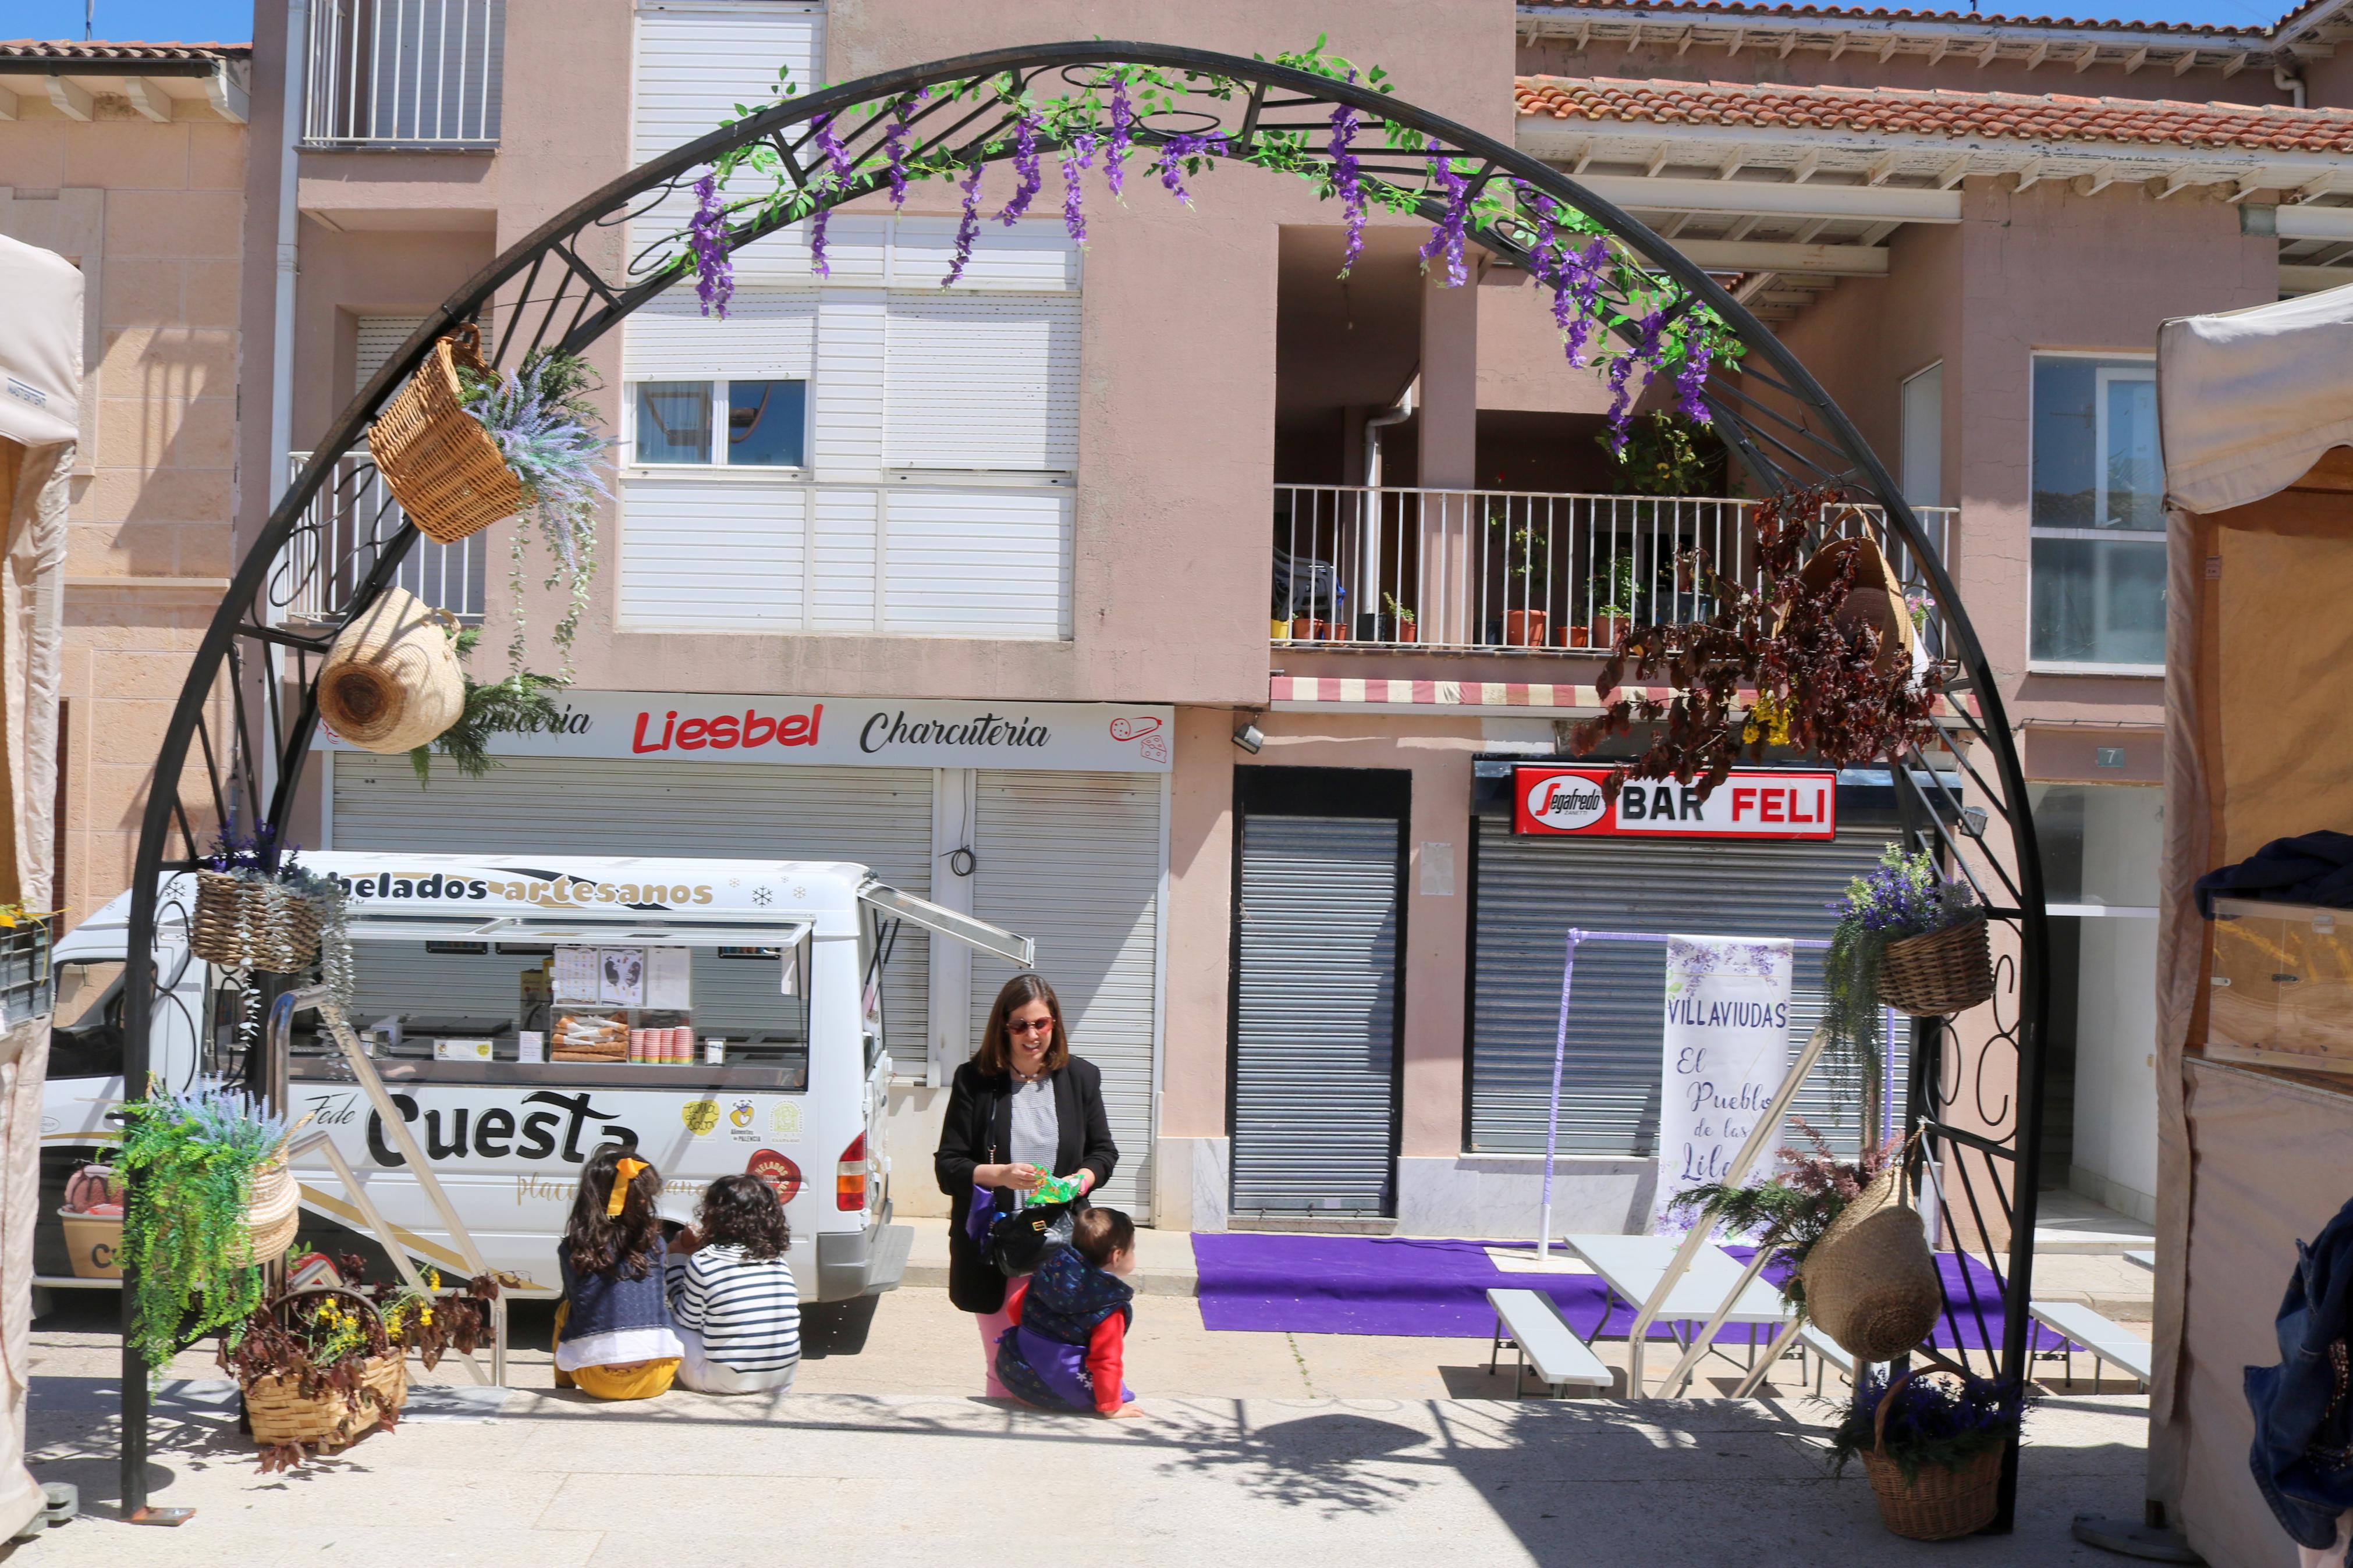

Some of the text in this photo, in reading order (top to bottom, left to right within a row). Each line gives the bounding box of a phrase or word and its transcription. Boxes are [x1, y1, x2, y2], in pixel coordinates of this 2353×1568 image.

[633, 703, 824, 753] Liesbel
[2107, 749, 2116, 763] 7
[1535, 783, 1600, 816] Segafredo
[1623, 786, 1825, 823] BAR FELI
[505, 875, 714, 905] artesanos
[1668, 999, 1787, 1029] VILLAVIUDAS
[1677, 1047, 1706, 1075] El
[1687, 1081, 1773, 1112] Pueblo
[304, 1090, 639, 1168] Fede Cuesta
[1694, 1117, 1750, 1138] de las
[755, 1161, 788, 1176] HELADOS
[1681, 1142, 1733, 1181] Lil
